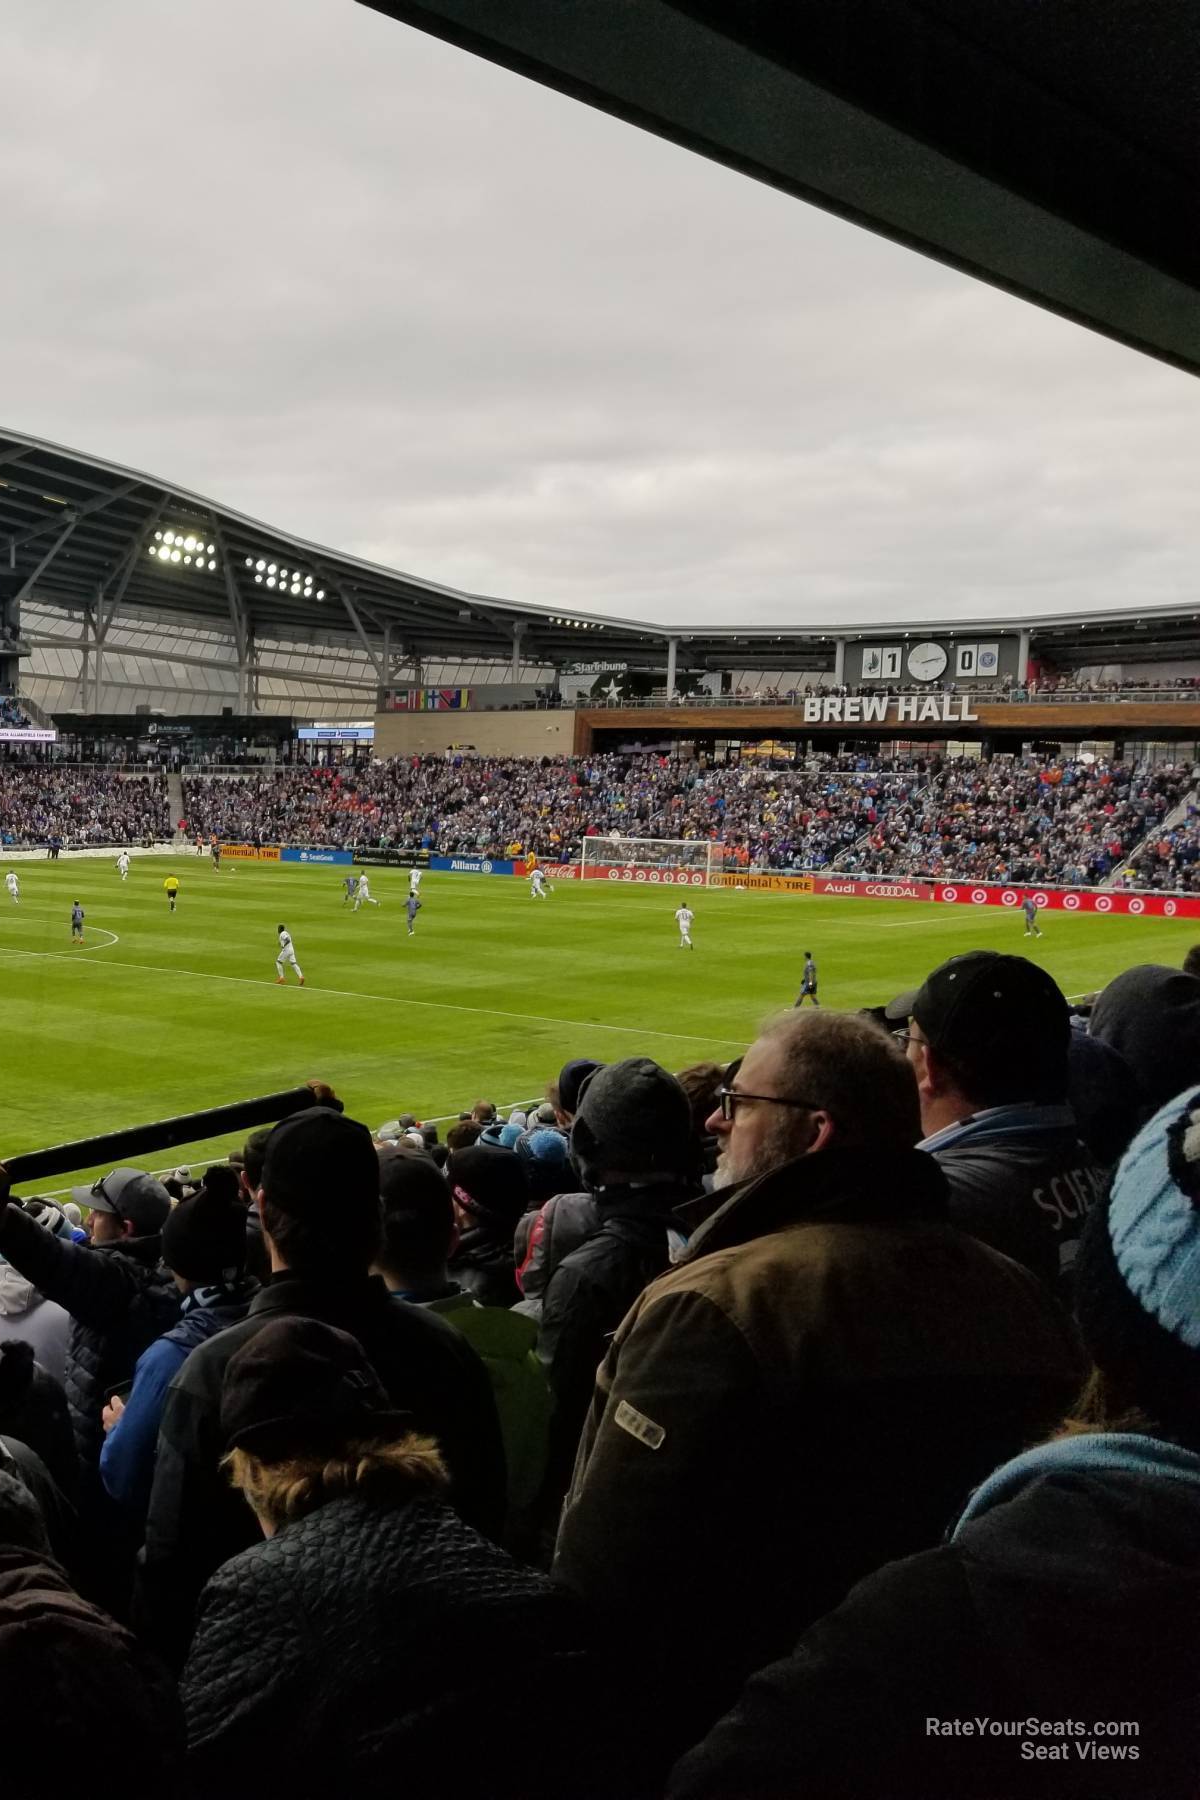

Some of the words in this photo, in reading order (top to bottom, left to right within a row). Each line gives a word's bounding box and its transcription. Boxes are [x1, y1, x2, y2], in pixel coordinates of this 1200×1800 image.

[573, 661, 627, 673] StarTribune
[888, 653, 896, 673] 1
[961, 650, 973, 671] 0
[804, 696, 888, 722] BREW
[898, 695, 978, 722] HALL
[220, 848, 254, 857] ntinental
[262, 850, 278, 858] TIRE
[451, 860, 480, 871] Allianz
[709, 873, 771, 888] Continental
[784, 880, 812, 891] TIRE
[824, 882, 855, 893] Audi
